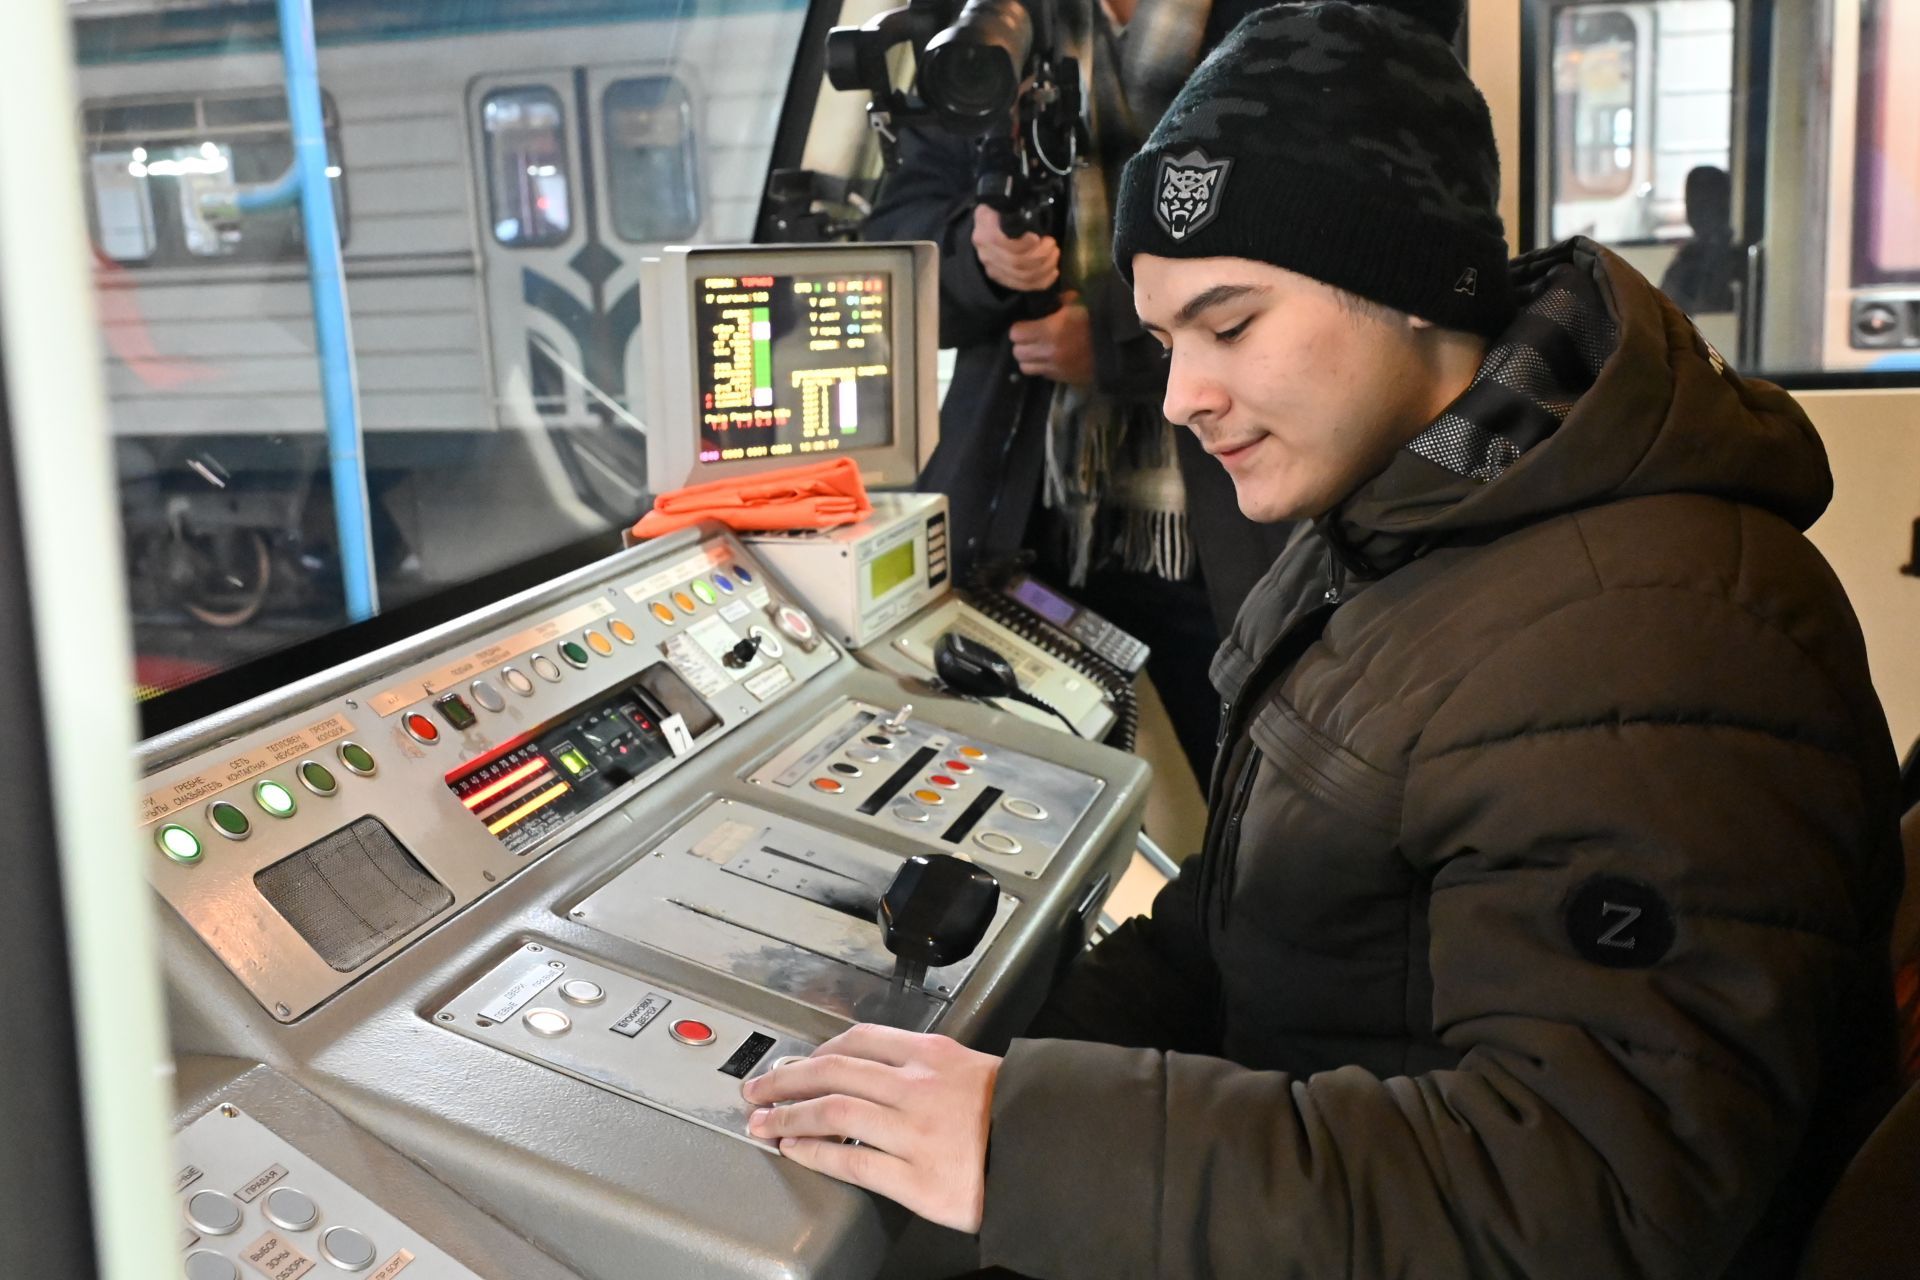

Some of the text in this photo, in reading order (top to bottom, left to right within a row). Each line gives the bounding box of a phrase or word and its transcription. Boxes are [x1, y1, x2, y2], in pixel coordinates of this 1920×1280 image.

[229, 758, 250, 770] СЕТЬ
[173, 781, 223, 806] СМАЗЫВАТЕЛЬ
[226, 760, 268, 781] КОНТАКТНАЯ
[1597, 901, 1641, 949] Z
[503, 983, 528, 1000] ДВЕРИ
[618, 998, 655, 1028] БЛОКИРОВКА
[635, 1006, 659, 1027] ДВЕРЕЙ
[244, 1170, 279, 1195] ПРАВАЯ
[250, 1238, 277, 1262] ВЫБОР
[266, 1250, 290, 1270] ЗОНЫ
